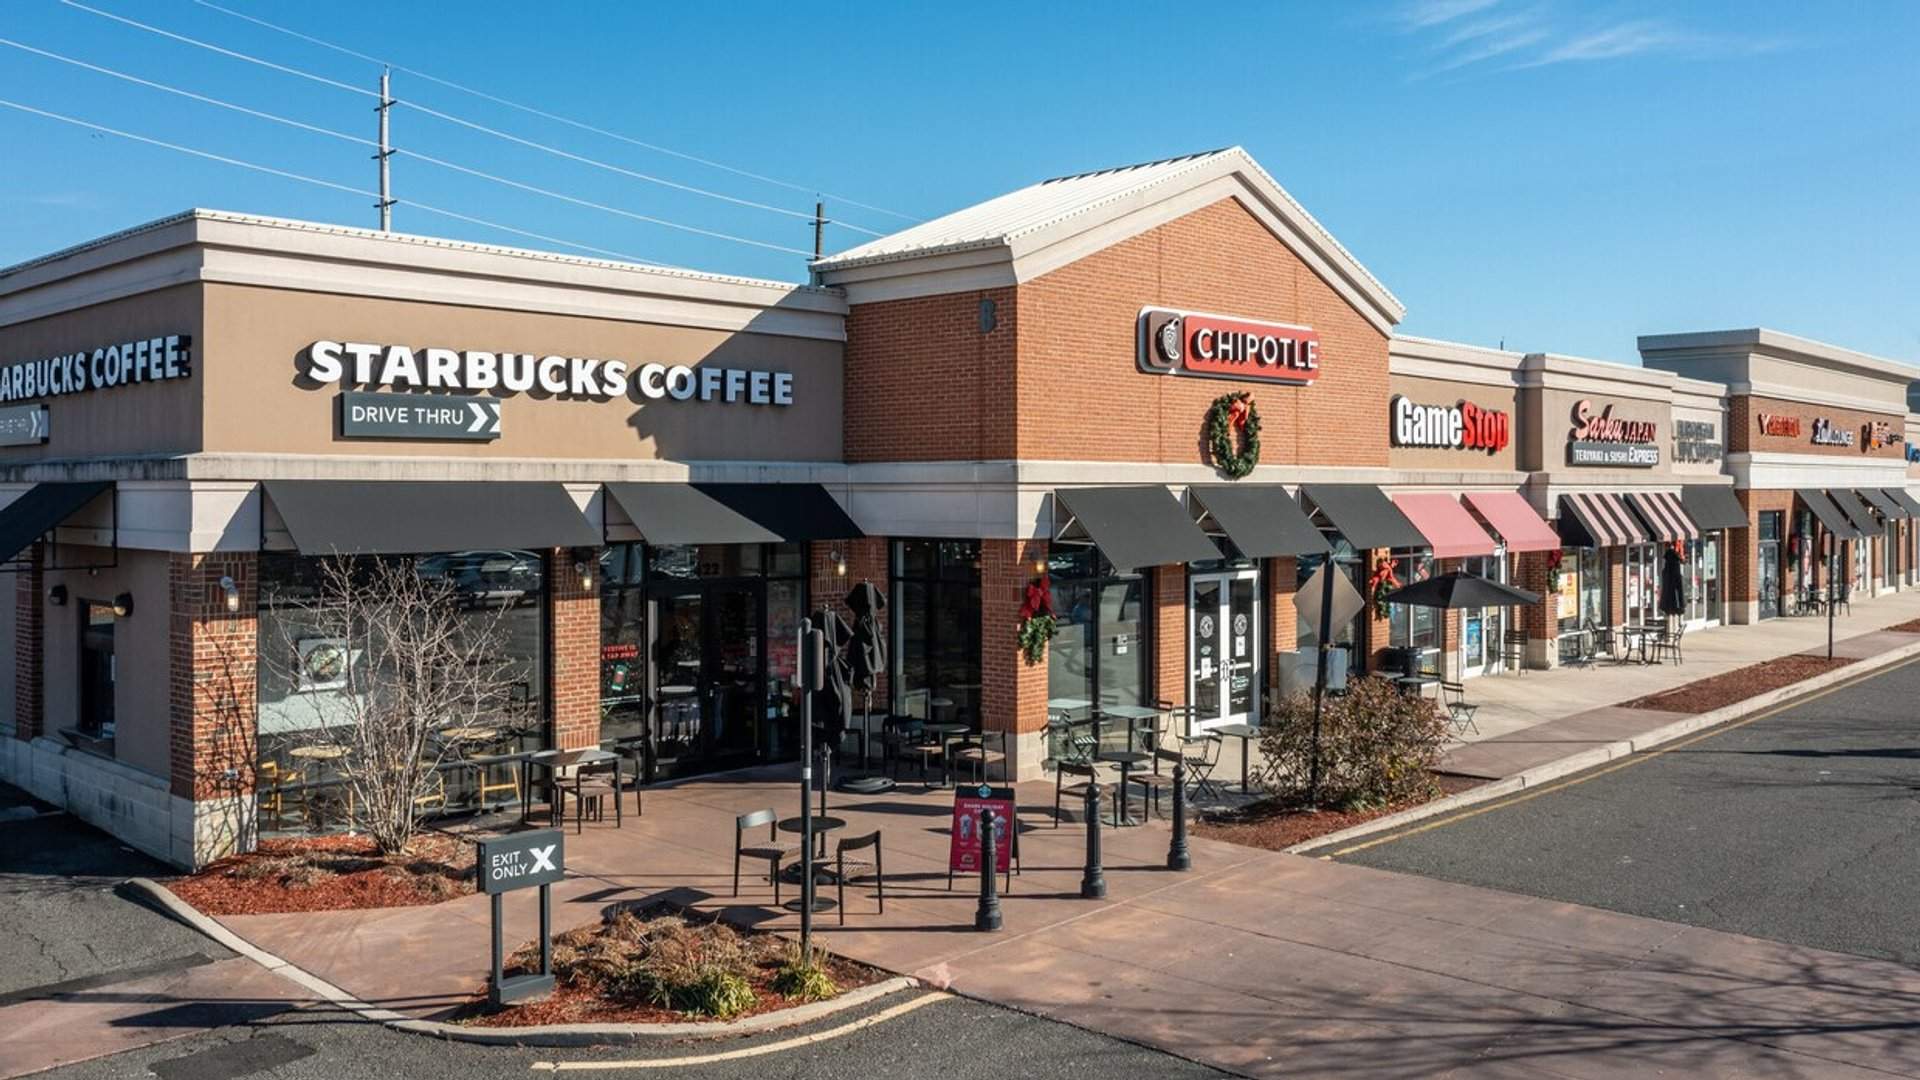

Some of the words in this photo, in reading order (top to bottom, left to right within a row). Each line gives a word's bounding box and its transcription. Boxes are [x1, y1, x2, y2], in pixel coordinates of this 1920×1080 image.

[1198, 328, 1319, 369] CHIPOTLE
[91, 335, 179, 388] COFFEE
[309, 341, 628, 397] STARBUCKS
[640, 363, 793, 405] COFFEE
[352, 406, 408, 424] DRIVE
[415, 408, 464, 425] THRU
[1397, 396, 1509, 452] GameStop
[1624, 420, 1657, 441] JAPAN
[1629, 446, 1658, 463] EXPRESS
[492, 851, 520, 867] EXIT
[492, 863, 528, 880] ONLY
